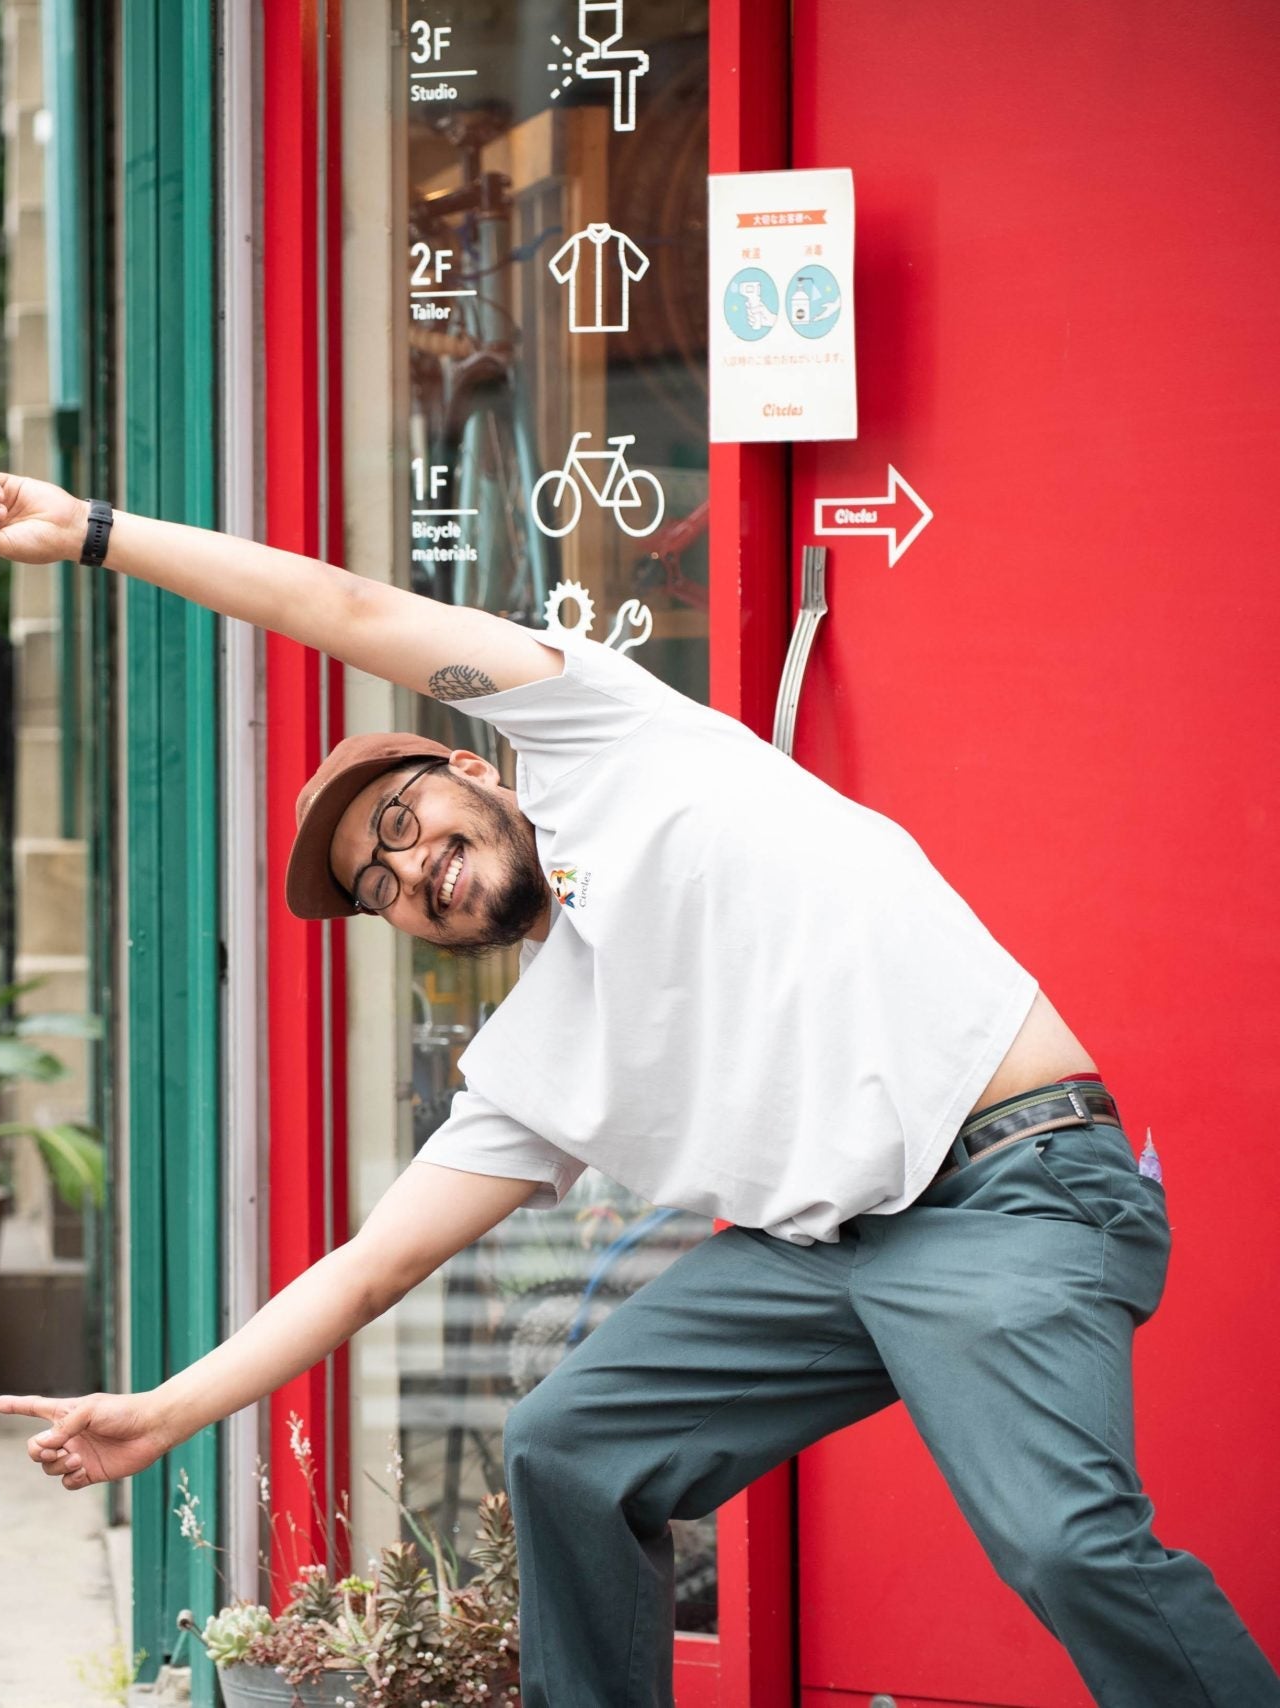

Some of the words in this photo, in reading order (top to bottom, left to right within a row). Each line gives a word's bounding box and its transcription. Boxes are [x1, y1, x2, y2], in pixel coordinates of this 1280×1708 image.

[410, 19, 452, 64] 3F
[410, 83, 458, 102] Studio
[410, 242, 454, 287] 2F
[410, 302, 452, 321] Tailor
[763, 403, 804, 417] Circles
[411, 457, 449, 501] 1F
[834, 508, 878, 525] Circles
[412, 520, 462, 543] Bicycle
[412, 543, 478, 562] materials
[579, 871, 592, 908] Circles
